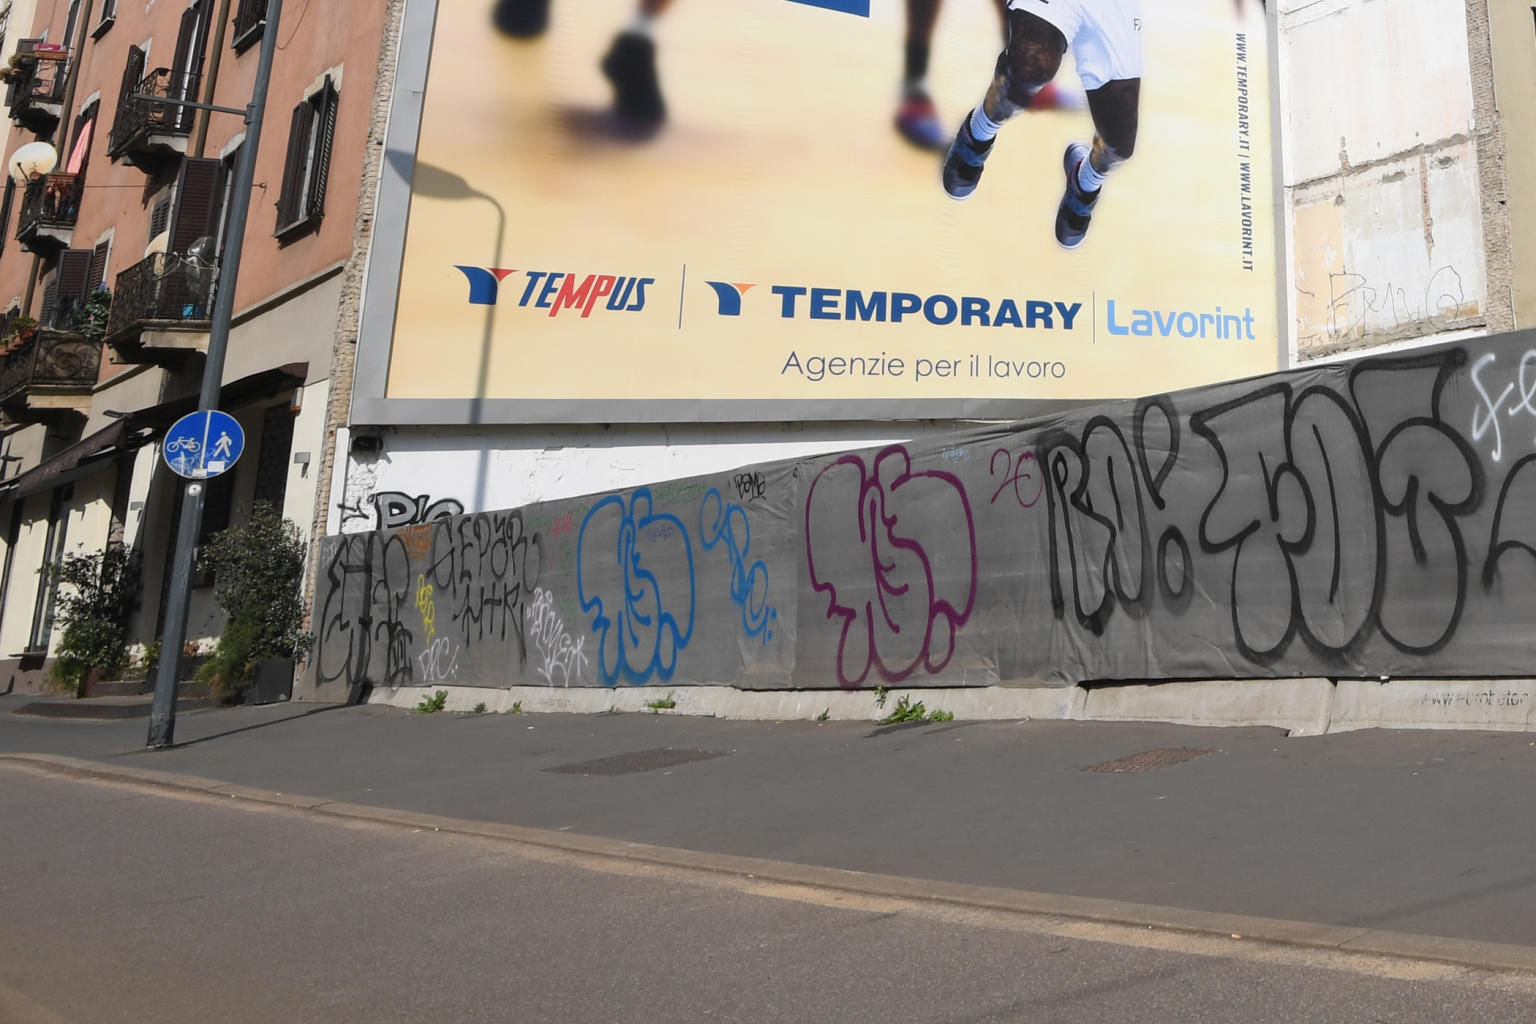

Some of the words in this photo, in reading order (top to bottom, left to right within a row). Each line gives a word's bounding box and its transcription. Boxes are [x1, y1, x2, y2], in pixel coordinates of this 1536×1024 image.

[1235, 32, 1250, 151] WWW.TEMPORARY.IT
[1240, 162, 1253, 271] WWW.LAVORINT.IT
[518, 271, 655, 318] TEMPUS
[771, 285, 1082, 330] TEMPORARY
[1107, 299, 1256, 341] Lavorint
[781, 350, 905, 382] Agenzie
[915, 357, 962, 382] per
[970, 353, 979, 377] il
[989, 355, 1066, 378] lavoro
